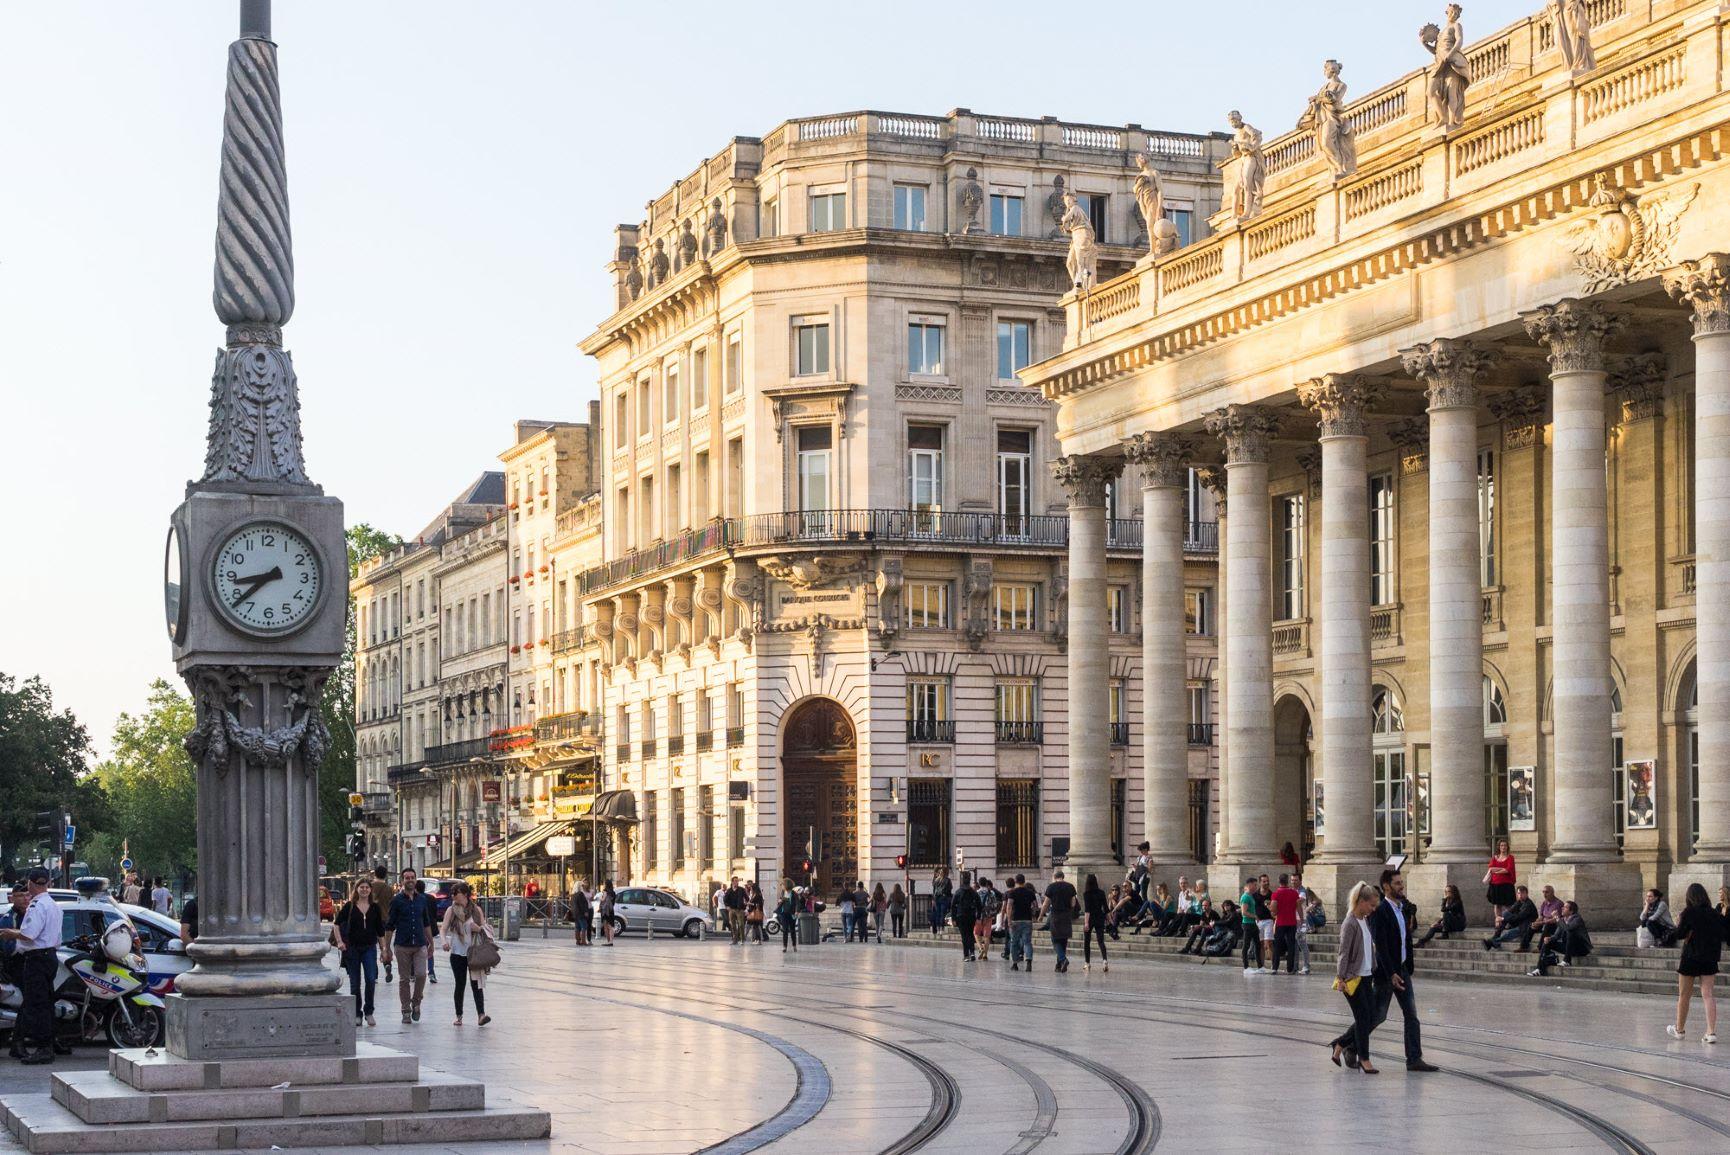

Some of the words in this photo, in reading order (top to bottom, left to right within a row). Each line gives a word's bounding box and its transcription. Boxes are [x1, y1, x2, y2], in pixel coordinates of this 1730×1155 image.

[246, 539, 254, 551] 11
[262, 535, 275, 547] 12
[284, 541, 288, 552] 1
[231, 553, 245, 565] 10
[294, 554, 305, 565] 2
[226, 570, 238, 582] 9
[300, 573, 309, 584] 3
[232, 588, 242, 600] 8
[293, 589, 304, 600] 4
[245, 602, 255, 613] 7
[263, 608, 274, 618] 6
[282, 603, 292, 614] 5
[89, 976, 113, 989] POLICE
